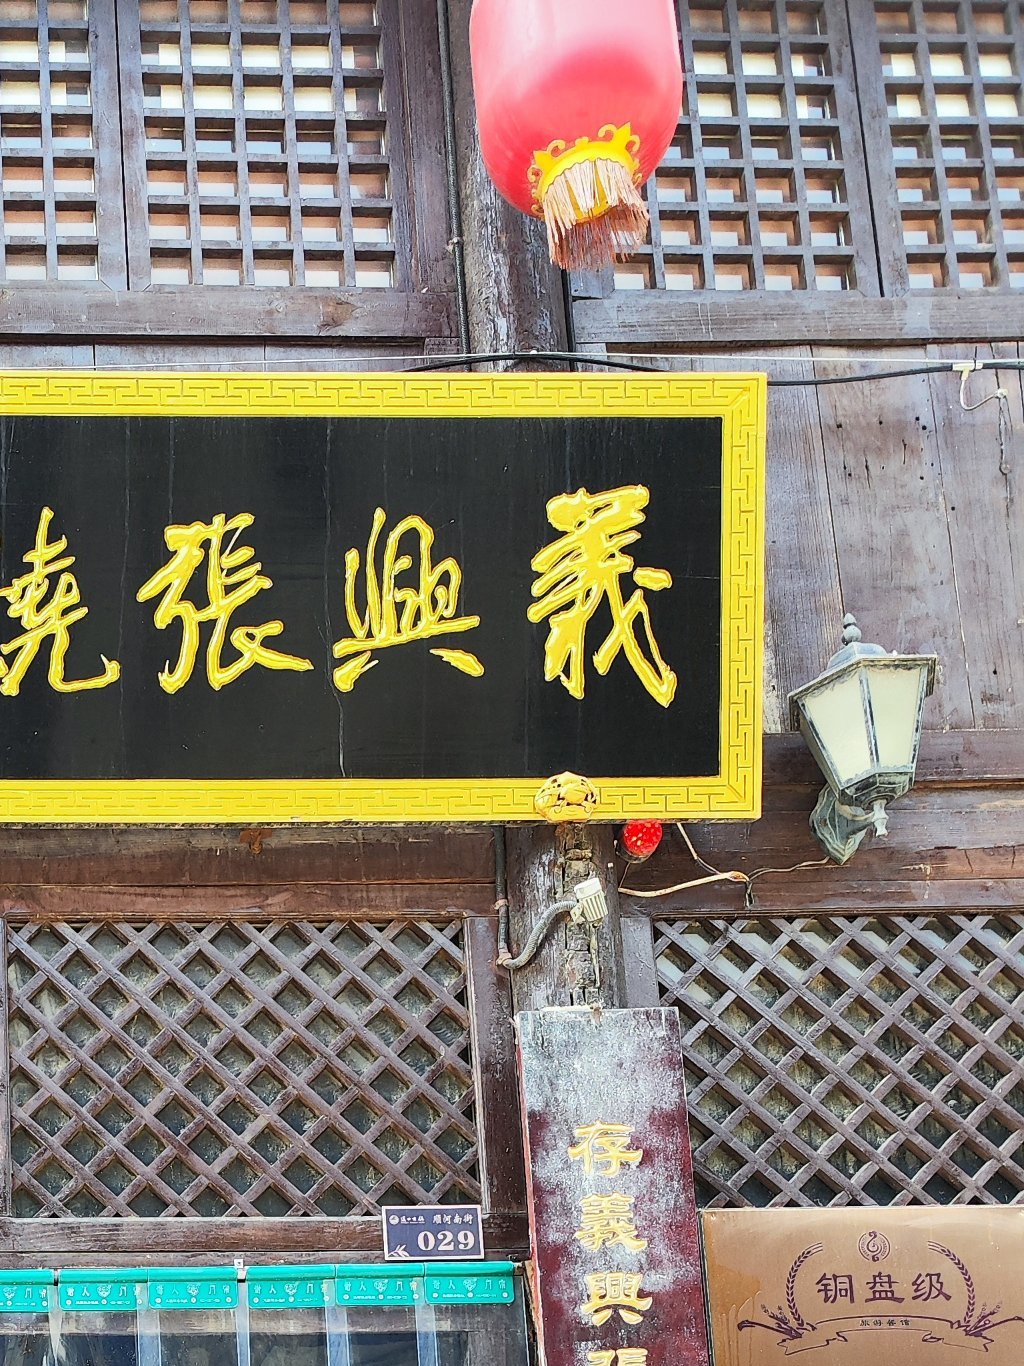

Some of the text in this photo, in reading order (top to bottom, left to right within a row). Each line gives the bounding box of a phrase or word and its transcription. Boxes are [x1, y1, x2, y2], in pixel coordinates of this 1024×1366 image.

[417, 1230, 475, 1251] 029
[815, 1271, 952, 1304] 铜盘级
